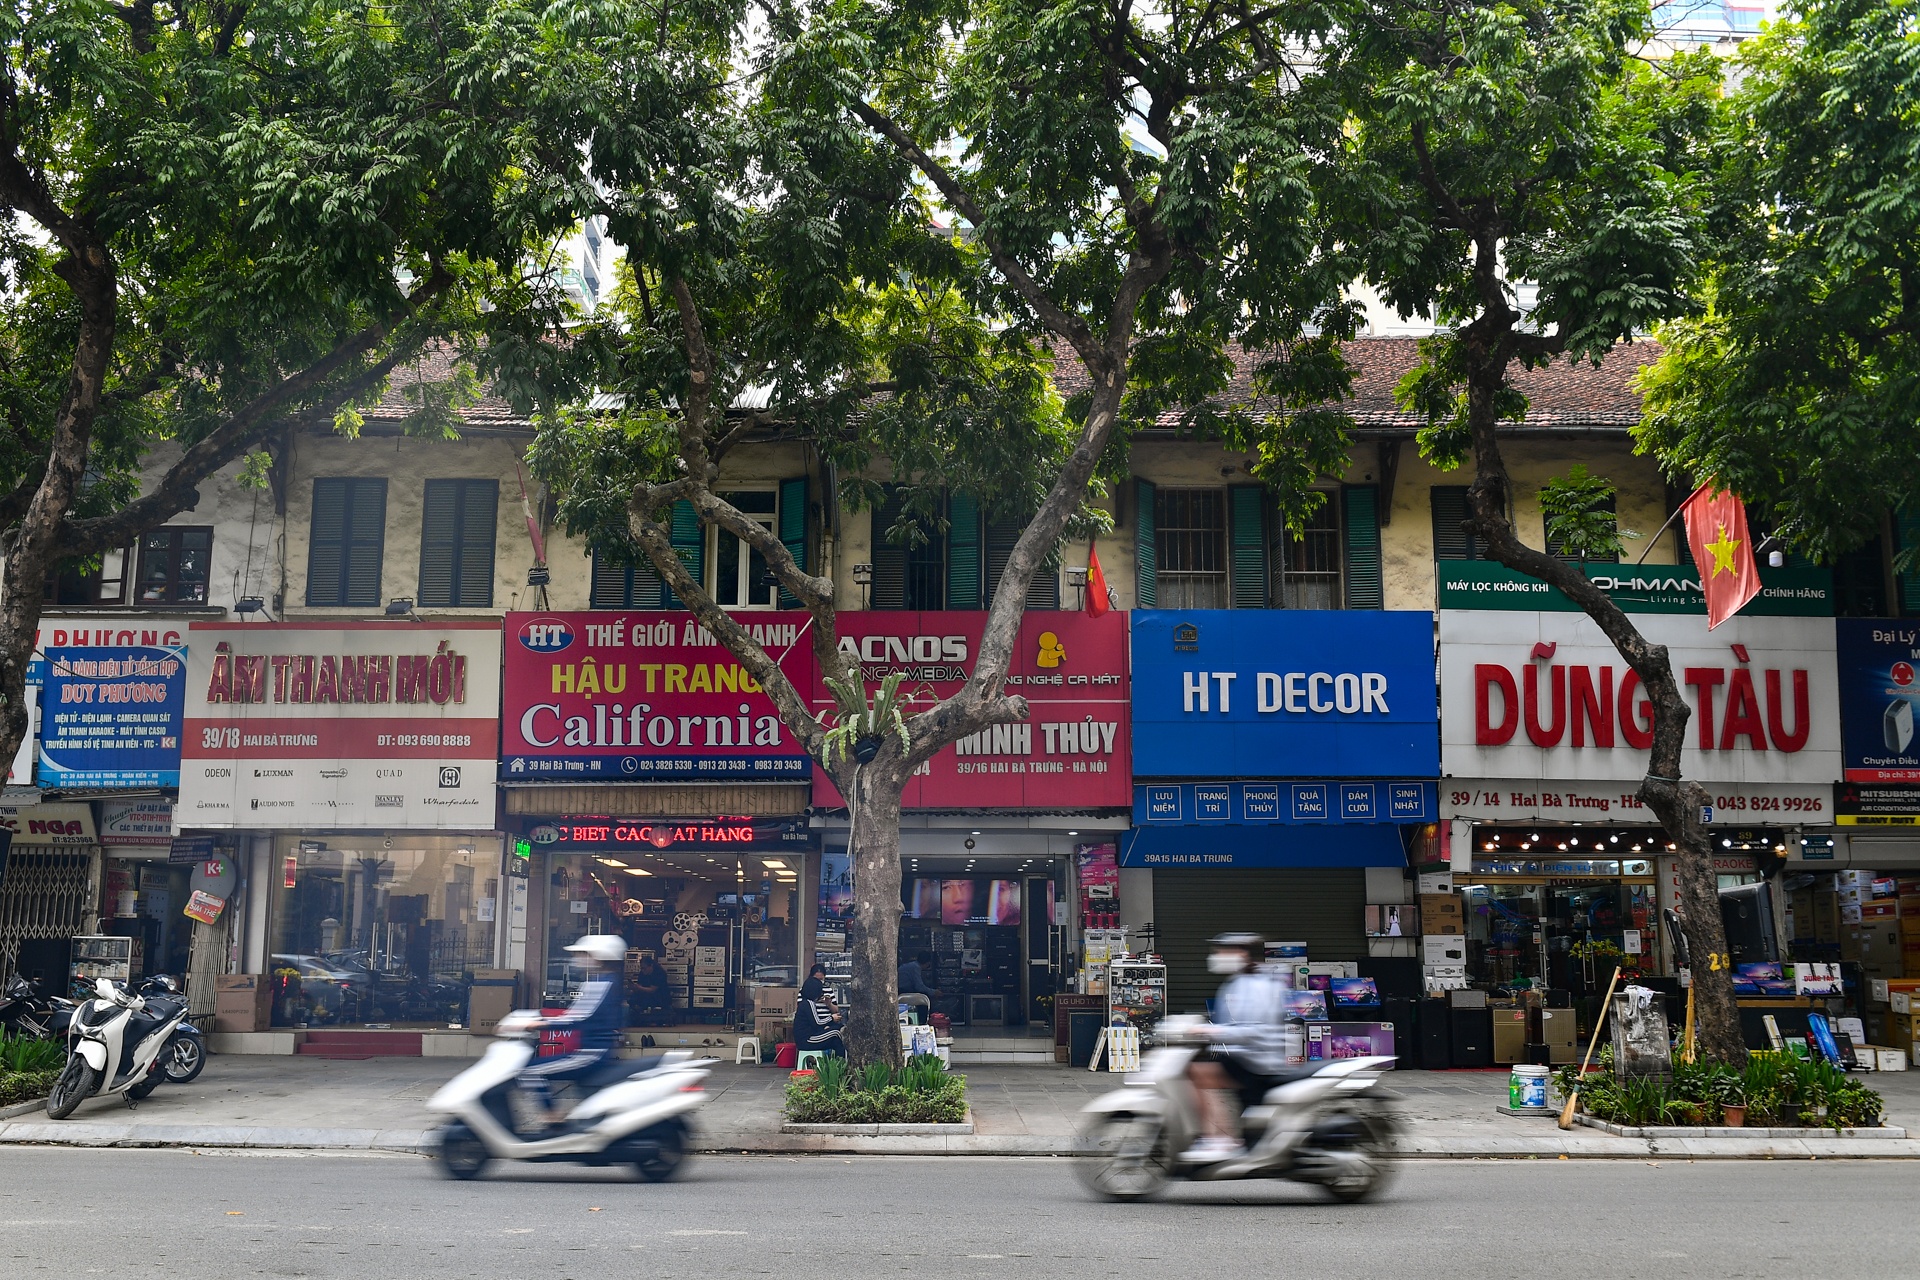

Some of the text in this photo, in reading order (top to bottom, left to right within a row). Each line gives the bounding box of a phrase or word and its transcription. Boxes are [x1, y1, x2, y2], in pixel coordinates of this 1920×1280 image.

[1447, 579, 1530, 593] MÁY LỌC KHÔNG
[1763, 586, 1827, 599] CHÍNH HÃNG
[1651, 595, 1686, 604] Living
[528, 624, 565, 647] HT
[585, 617, 717, 647] THẾ GIỚI ÂM
[1872, 630, 1916, 645] Đại Lý
[837, 636, 968, 663] ACNOS
[206, 639, 467, 705] ÂM THANH MỚI
[551, 656, 763, 700] HẬU TRANG
[1027, 672, 1121, 687] NGHỆ CA HÁT
[61, 682, 167, 703] DUY PHƯƠNG
[1183, 671, 1390, 714] HT DECOR
[1474, 641, 1811, 753] DŨNG TÀU
[117, 713, 141, 723] CAMERA
[142, 714, 159, 723] QUAN
[68, 727, 87, 736] THANH
[88, 727, 115, 736] KARAOKE
[148, 726, 166, 735] CASIO
[520, 703, 782, 748] California
[202, 727, 318, 749] 39/18 HAI BÀ TRƯNG
[378, 734, 471, 747] ĐT: 093 690 8888
[956, 715, 1118, 755] MINH THỦY
[101, 740, 115, 749] TINH
[115, 740, 124, 749] AN
[144, 739, 155, 748] VTC
[529, 759, 601, 773] 39 Hai Bà Trưng HN
[640, 760, 803, 771] 024 3826 5330 0913 20 3438 0983 20 3438
[957, 759, 1108, 775] 39/16 HAI BÀ TRƯNG HÀ NỘI
[1863, 756, 1897, 766] Chuyên
[205, 768, 231, 778] ODEON
[263, 769, 294, 777] LUXMAN
[376, 769, 403, 778] QUAD
[1155, 791, 1173, 801] LƯU
[1198, 792, 1228, 801] TRANG
[1245, 792, 1277, 801] PHONG
[1348, 789, 1368, 801] ĐÁM
[1396, 790, 1418, 799] SINH
[423, 798, 480, 807] Wharfedale
[1153, 801, 1176, 813] NIỆM
[1206, 802, 1220, 813] TRÍ
[1249, 801, 1274, 813] THỦY
[1298, 801, 1322, 814] TẶNG
[1348, 801, 1369, 813] CƯỚI
[1394, 799, 1420, 812] NHẬT
[1511, 791, 1610, 812] Hai Bà Trưng
[1717, 796, 1822, 812] 043 824 9926
[1856, 816, 1916, 824] HEAVY DUTY
[29, 819, 83, 836] NGA
[572, 827, 610, 841] BIET
[701, 827, 753, 841] HANG
[1144, 853, 1233, 863] 39A15 HAI BA TRUNG
[1714, 858, 1753, 869] RAOKE
[207, 862, 224, 875] K+
[189, 903, 202, 913] SIM
